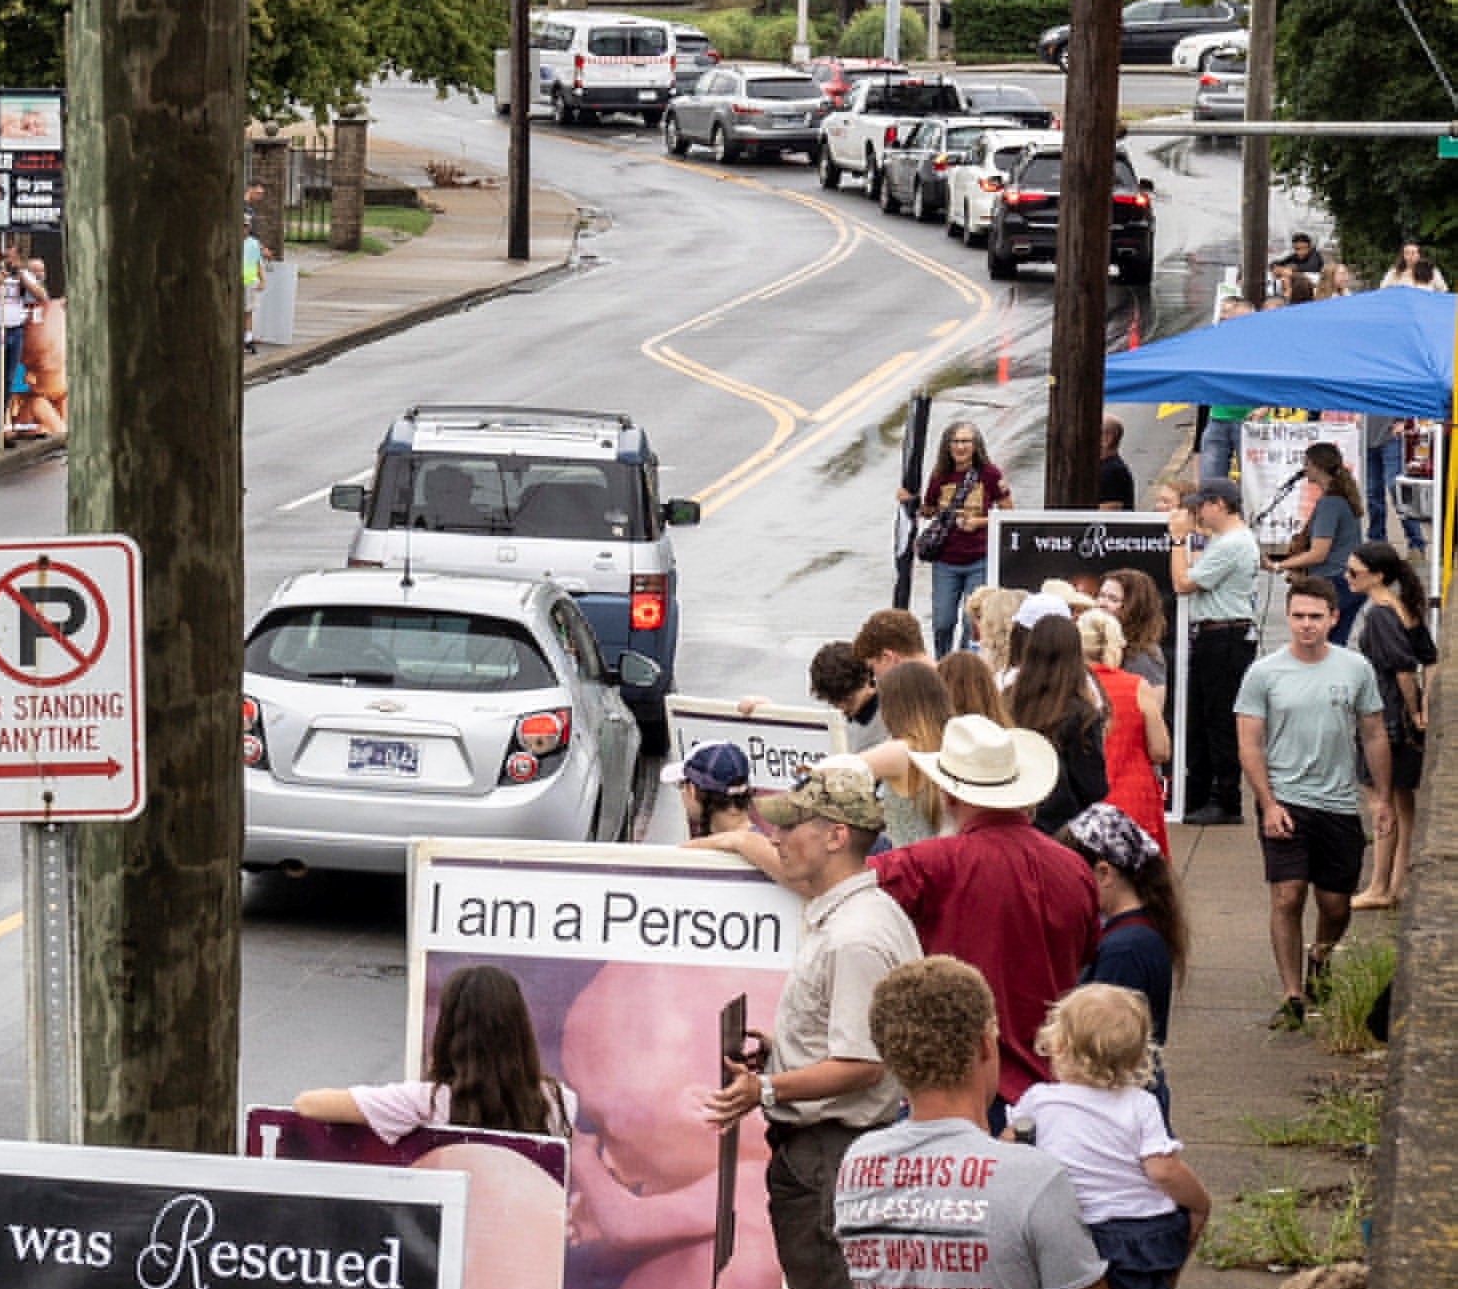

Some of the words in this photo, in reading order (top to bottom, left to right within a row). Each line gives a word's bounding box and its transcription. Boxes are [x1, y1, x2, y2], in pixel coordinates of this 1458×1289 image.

[1011, 531, 1021, 551] I
[1034, 535, 1073, 553] was
[12, 692, 125, 721] STANDING
[428, 881, 441, 935] I
[457, 896, 536, 942] am
[552, 902, 584, 943] a
[601, 891, 782, 954] Person
[849, 1155, 890, 1190] THE
[892, 1155, 955, 1189] DAYS
[959, 1156, 1000, 1189] OF
[8, 1221, 115, 1269] was
[884, 1240, 927, 1272] WHO
[930, 1240, 989, 1273] KEEP
